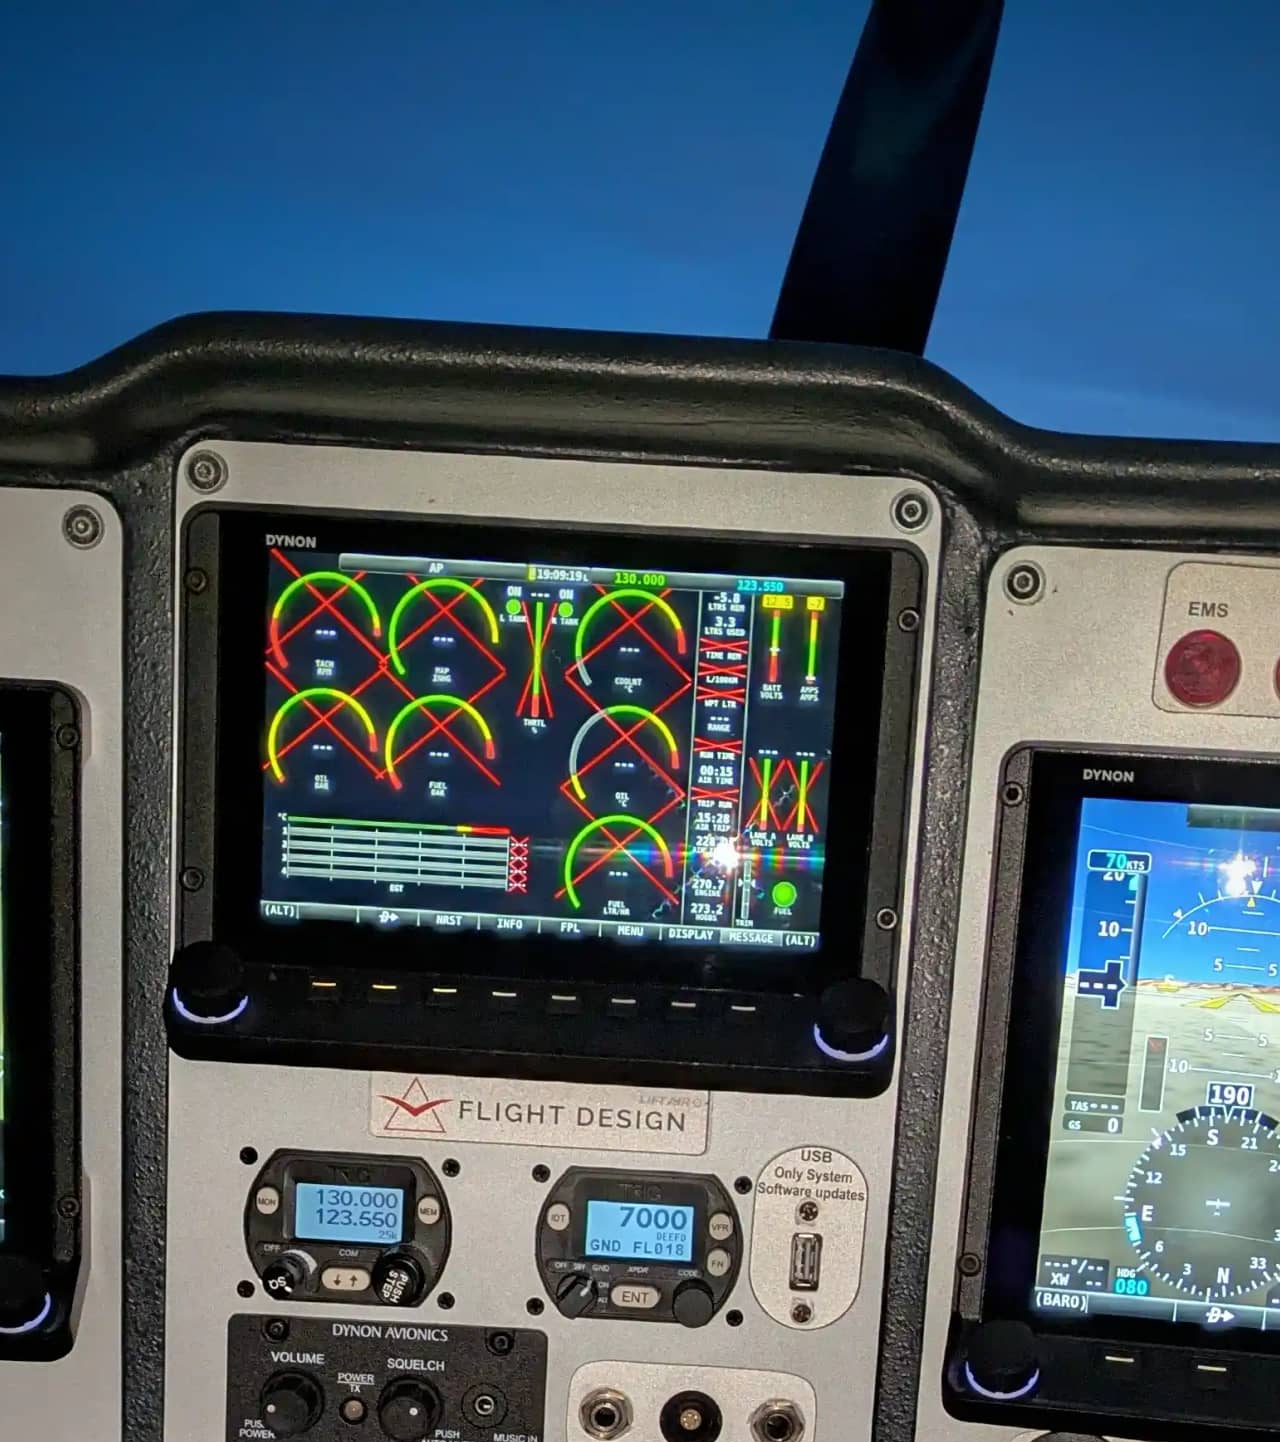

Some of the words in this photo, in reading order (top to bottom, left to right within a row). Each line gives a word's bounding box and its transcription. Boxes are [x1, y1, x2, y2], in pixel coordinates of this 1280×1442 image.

[266, 534, 316, 548] DYNON
[1188, 602, 1229, 617] EMS
[1083, 769, 1135, 783] DYNON
[618, 926, 644, 936] MENU
[669, 928, 714, 940] DISPLAY
[729, 932, 774, 943] MESSAGE
[1210, 1087, 1249, 1105] 190
[459, 1100, 564, 1126] FLIGHT
[577, 1107, 685, 1131] DESIGN
[801, 1150, 832, 1162] USB
[775, 1167, 803, 1181] Only
[807, 1169, 852, 1184] System
[317, 1190, 397, 1208] 130.000
[758, 1182, 811, 1197] Software
[816, 1189, 864, 1201] updates
[316, 1209, 397, 1227] 123.550
[620, 1207, 687, 1230] 7000
[712, 1223, 728, 1231] VFR
[591, 1239, 621, 1252] GND
[634, 1242, 684, 1255] FL018
[622, 1292, 649, 1303] ENT
[1036, 1291, 1086, 1310] (BARO)
[333, 1324, 381, 1338] DYNON
[385, 1328, 448, 1341] AVIONICS
[271, 1351, 325, 1364] VOLUME
[387, 1358, 445, 1371] SQUELCH
[338, 1373, 374, 1382] POWER
[435, 1430, 460, 1439] PUSH
[494, 1434, 525, 1442] MUSIC
[528, 1435, 538, 1442] IN
